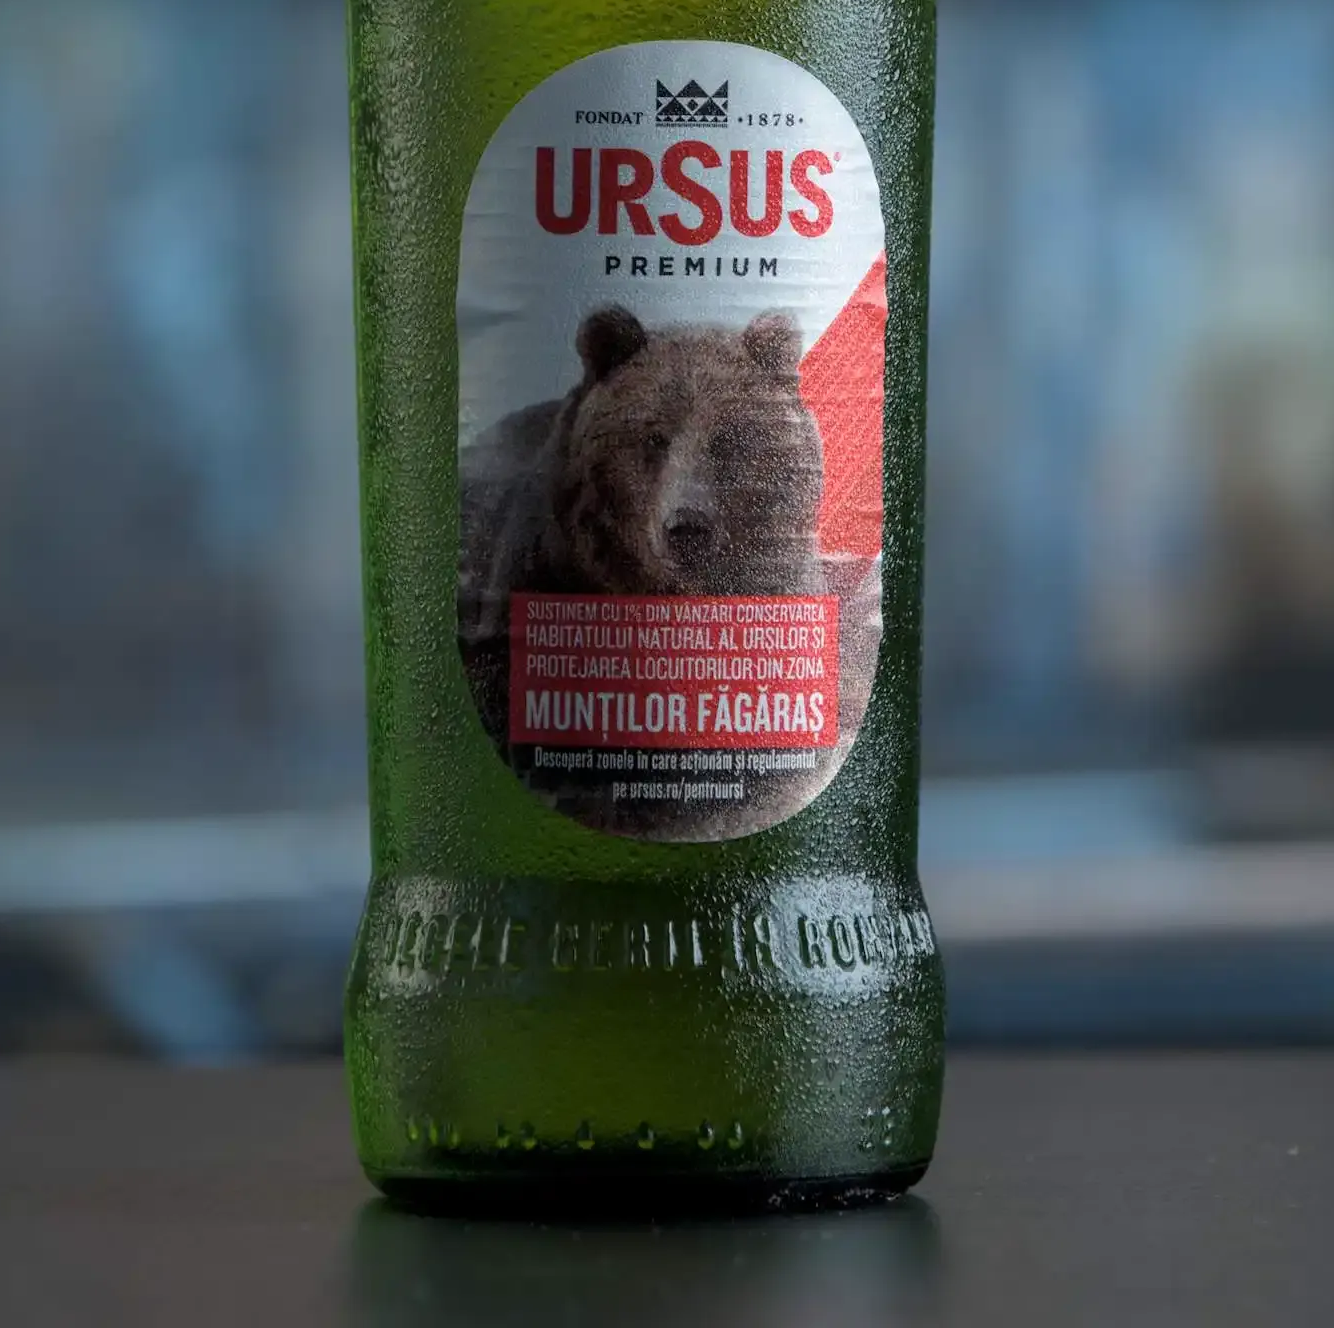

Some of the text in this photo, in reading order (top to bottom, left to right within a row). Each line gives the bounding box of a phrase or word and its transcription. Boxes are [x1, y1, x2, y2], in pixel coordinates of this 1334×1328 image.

[575, 110, 643, 125] FONDAT
[535, 140, 835, 246] URSUS
[605, 255, 779, 278] PREMIUM
[601, 603, 618, 621] CU
[624, 603, 642, 622] 1%
[646, 604, 670, 622] DIN
[736, 603, 826, 623] CONSERVAREA
[526, 624, 633, 648] HABITATULUI
[638, 626, 714, 650] NATURAL
[719, 627, 738, 650] AL
[743, 626, 808, 654] URȘILOR
[527, 654, 825, 680] PROTEJAREA LOCUITORILOR DIN ZONA
[525, 684, 824, 741] MUNȚILOR FĂGĂRAȘ
[535, 746, 593, 772] Descoperă
[596, 749, 634, 770] zonele
[637, 749, 648, 770] în
[652, 752, 677, 770] care
[747, 749, 816, 776] regulamentul
[613, 781, 628, 803] pe
